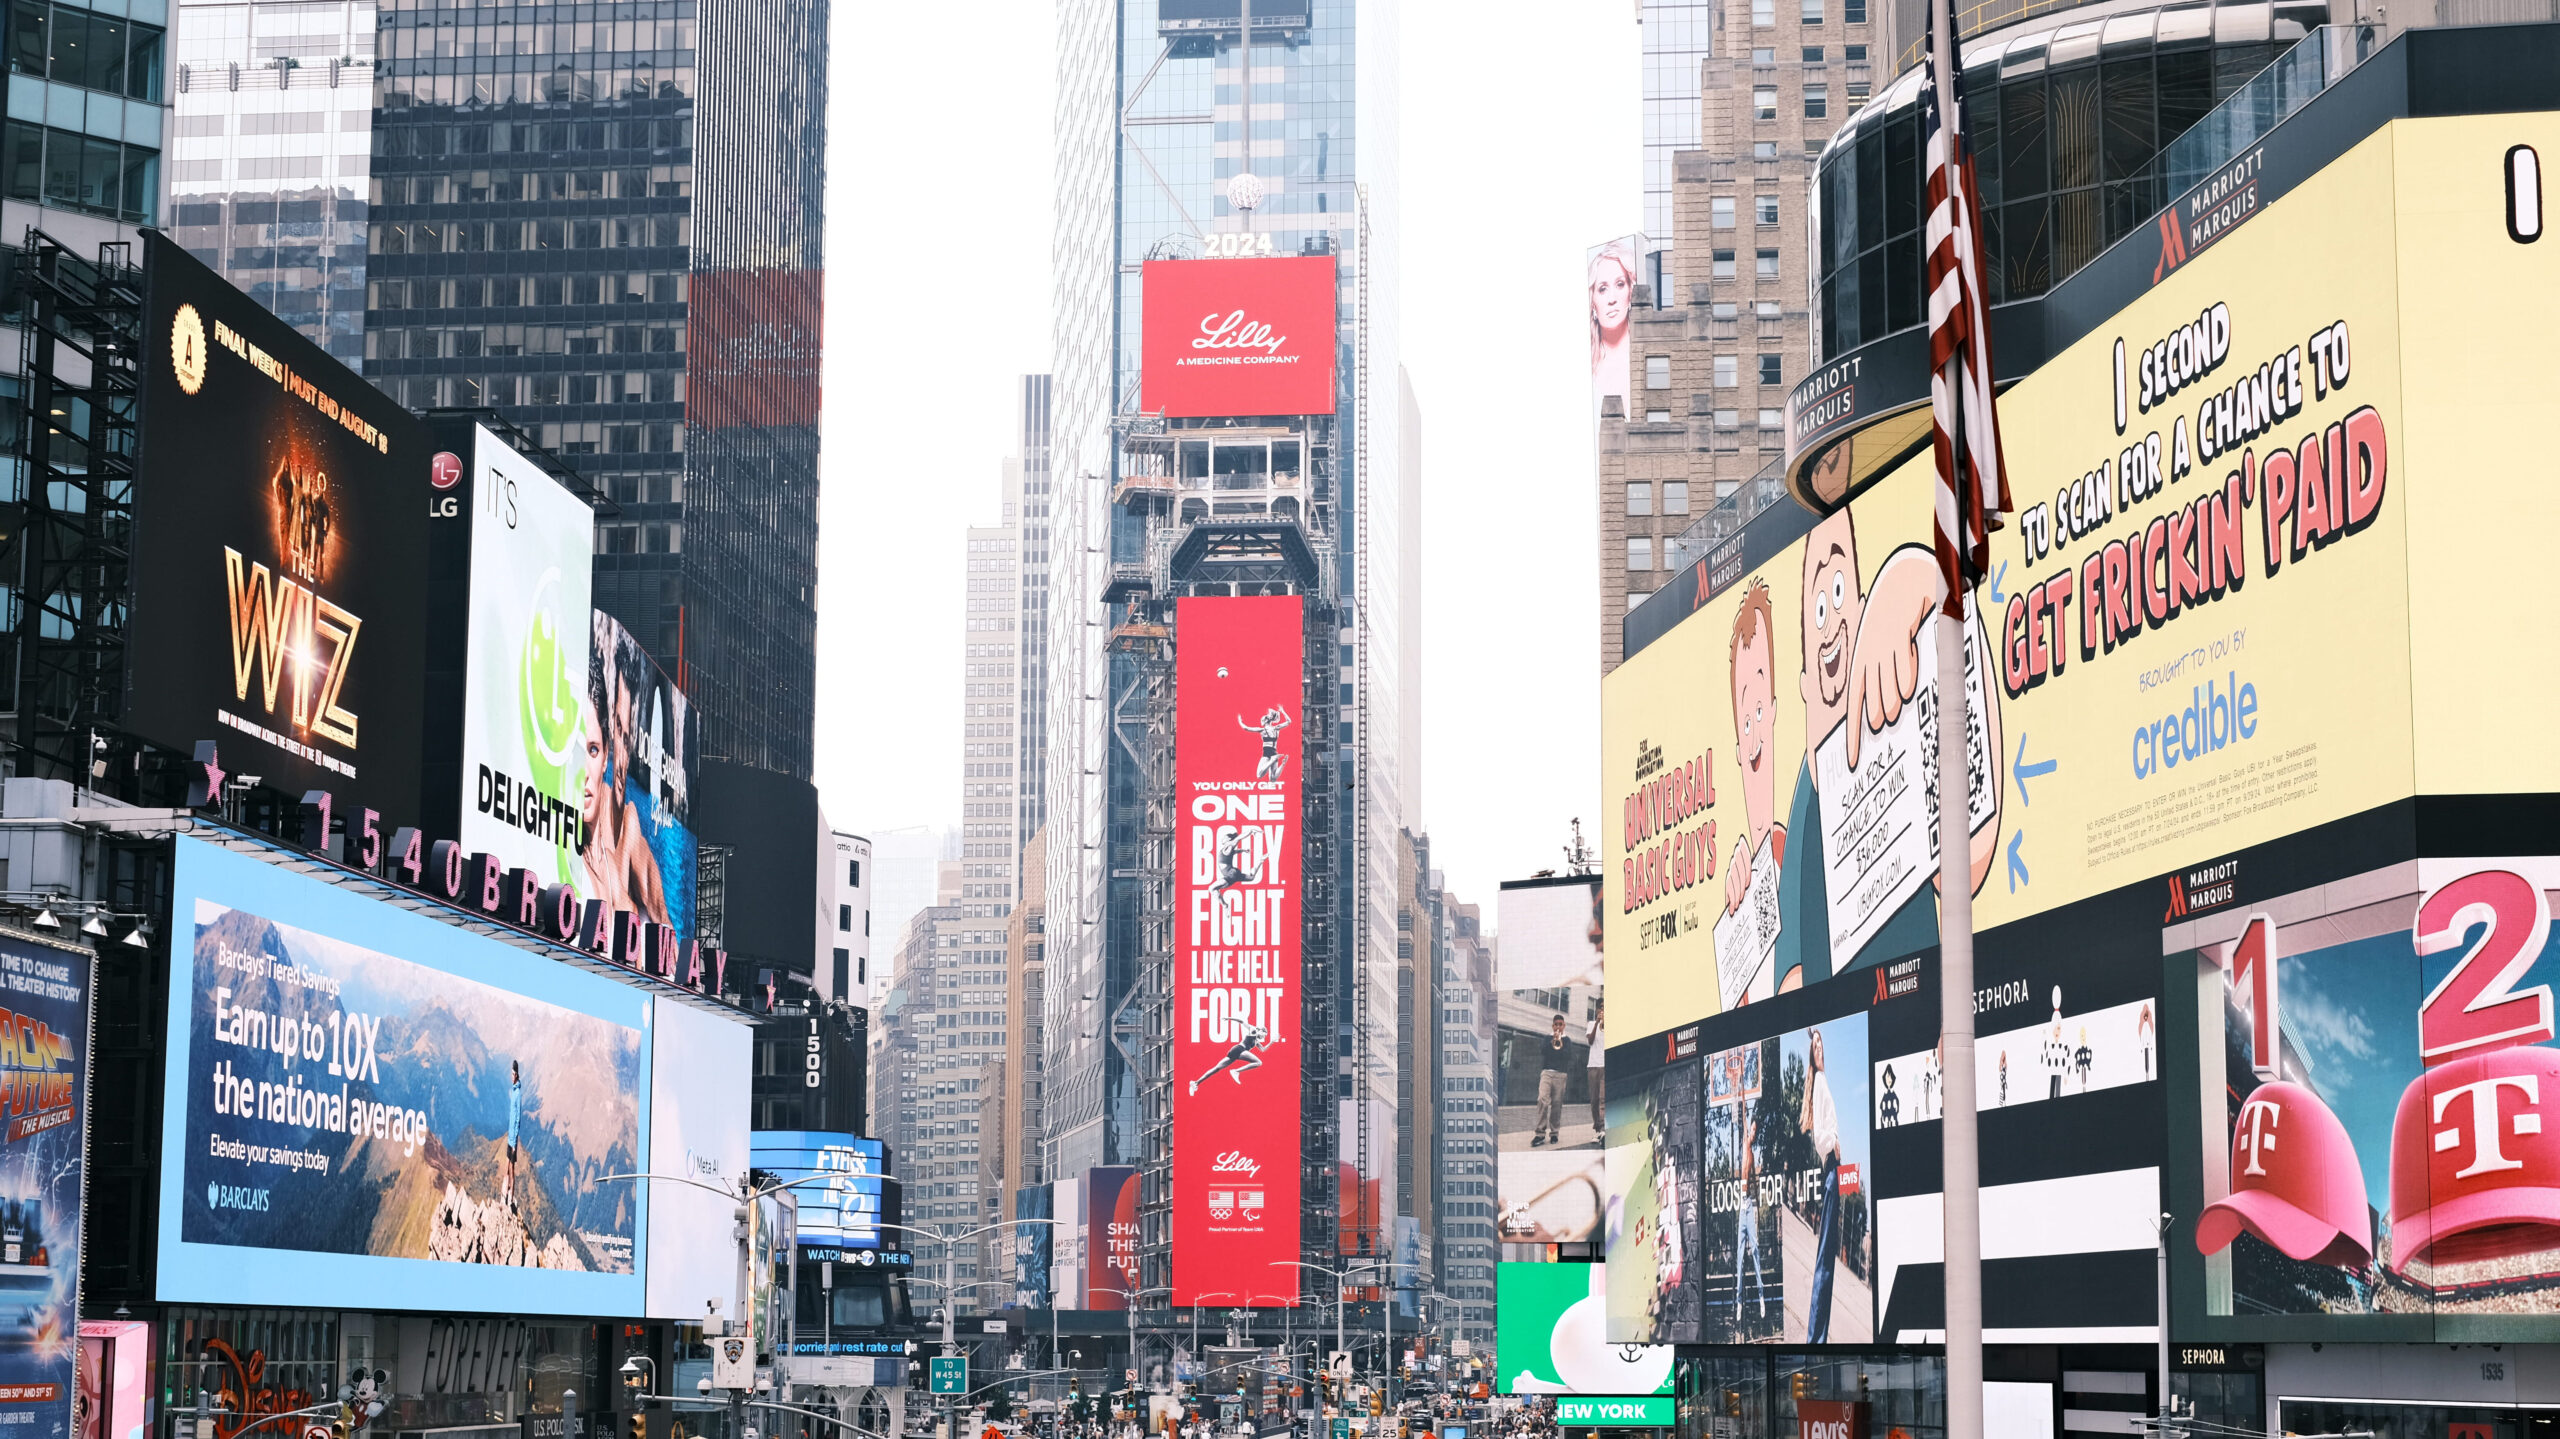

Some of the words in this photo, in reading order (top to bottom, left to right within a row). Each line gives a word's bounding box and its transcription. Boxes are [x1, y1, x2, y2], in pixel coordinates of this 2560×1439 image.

[2191, 147, 2264, 217] MARRIOTT
[2192, 186, 2255, 248] MARQUIS
[1204, 232, 1273, 257] 2024
[1192, 309, 1287, 355] Lilly
[185, 334, 193, 369] A
[1176, 357, 1185, 366] A
[1186, 357, 1242, 366] MEDICINE
[1243, 355, 1300, 365] COMPANY
[1795, 356, 1862, 414] MARRIOTT
[2114, 337, 2127, 436] I
[2139, 302, 2231, 414] SECOND
[214, 319, 248, 361] FINAL
[249, 342, 283, 384] WEEKS
[289, 371, 317, 406] MUST
[318, 391, 338, 421] END
[339, 407, 378, 447] AUGUST
[378, 432, 388, 455] 18
[1796, 391, 1851, 442] MARQUIS
[2021, 501, 2050, 567] TO
[2055, 458, 2112, 549] SCAN
[2119, 431, 2163, 513] FOR
[2172, 415, 2191, 484] A
[2198, 344, 2303, 466] CHANCE
[2309, 319, 2351, 402] TO
[429, 496, 458, 518] LG
[487, 465, 518, 530] IT'S
[290, 549, 314, 583] THE
[1711, 532, 1746, 569] MARRIOTT
[2001, 567, 2072, 700] GET
[2080, 447, 2255, 663] FRICKIN'
[2262, 404, 2387, 580] PAID
[1711, 557, 1742, 591] MARQUIS
[224, 545, 363, 750] WIZ
[2139, 652, 2189, 694] BROUGHT
[2192, 648, 2206, 667] TO
[2209, 637, 2230, 663] YOU
[2233, 627, 2247, 652] BY
[2132, 670, 2258, 780] credible
[1636, 757, 1664, 782] DOMINATION
[1637, 745, 1662, 769] ANIMATION
[1192, 781, 1221, 791] YOU
[1222, 781, 1256, 791] ONLY
[1257, 781, 1285, 791] GET
[1841, 774, 1864, 817] SCAN
[1866, 752, 1886, 786] FOR
[1887, 741, 1894, 762] A
[478, 763, 585, 857] DELIGHTFU
[1191, 794, 1285, 821] ONE
[1624, 747, 1716, 853] UNIVERSAL
[1836, 802, 1872, 858] CHANCE
[1873, 787, 1886, 816] TO
[1888, 764, 1905, 793] WIN
[1856, 821, 1889, 876] $36,000
[1624, 838, 1670, 915] BASIC
[1672, 819, 1717, 892] GUYS
[2190, 859, 2238, 888] MARRIOTT
[1857, 853, 1902, 918] UBGFOX.COM
[2190, 882, 2233, 911] MARQUIS
[481, 853, 728, 996] BROADWAY
[1191, 888, 1285, 947] FIGHT
[1640, 918, 1654, 950] SEPT
[1655, 917, 1660, 944] 8
[1660, 909, 1677, 943] FOX
[1684, 915, 1699, 934] hulu
[1, 953, 21, 972] TIME
[22, 958, 34, 974] TO
[34, 962, 69, 982] CHANGE
[218, 941, 265, 981] Barclays
[266, 954, 301, 986] Tiered
[301, 965, 340, 1001] Savings
[1191, 950, 1233, 984] LIKE
[1237, 950, 1284, 984] HELL
[1889, 957, 1921, 979] MARRIOTT
[7, 976, 45, 996] THEATER
[45, 984, 81, 1002] HISTORY
[1889, 976, 1918, 996] MARQUIS
[1972, 978, 2029, 1016] SEPHORA
[1190, 987, 1251, 1044] FOR
[215, 986, 268, 1050] Earn
[270, 1014, 299, 1070] up
[301, 1011, 325, 1063] to
[328, 1010, 381, 1084] 10X
[1677, 1026, 1699, 1042] MARRIOTT
[1677, 1041, 1697, 1056] MARQUIS
[805, 1018, 820, 1088] 1500
[0, 1070, 74, 1119] FUTURE
[213, 1060, 255, 1119] the
[258, 1073, 348, 1133] national
[350, 1097, 427, 1158] average
[20, 1117, 38, 1135] THE
[38, 1108, 71, 1130] MUSICAL
[210, 1133, 246, 1160] Elevate
[246, 1144, 268, 1167] your
[269, 1145, 303, 1173] savings
[303, 1150, 330, 1176] today
[696, 1156, 712, 1174] Meta
[1212, 1150, 1261, 1178] Lilly
[220, 1184, 270, 1212] BARCLAYS
[1507, 1200, 1530, 1211] Save
[1711, 1179, 1748, 1213] LOOSE
[1759, 1174, 1783, 1207] FOR
[1795, 1168, 1822, 1203] LIFE
[1506, 1217, 1535, 1228] Music
[1507, 1210, 1528, 1220] The
[807, 1248, 841, 1261] WATCH
[879, 1252, 899, 1264] THE
[1016, 1235, 1034, 1256] MAKE
[1107, 1239, 1138, 1252] THE
[1016, 1263, 1026, 1283] AN
[1016, 1289, 1038, 1309] IMPACT
[422, 1318, 526, 1394] FOREVER
[866, 1342, 889, 1353] rate
[890, 1342, 904, 1352] cut
[943, 1360, 954, 1369] TO
[2182, 1348, 2225, 1365] SEPHORA
[935, 1371, 941, 1379] W
[942, 1371, 953, 1379] 45
[954, 1371, 962, 1379] St
[2480, 1362, 2504, 1381] 1535
[23, 1387, 36, 1398] AND
[534, 1420, 545, 1437] U.S.
[1597, 1404, 1646, 1419] YORK
[1382, 1430, 1398, 1438] 25
